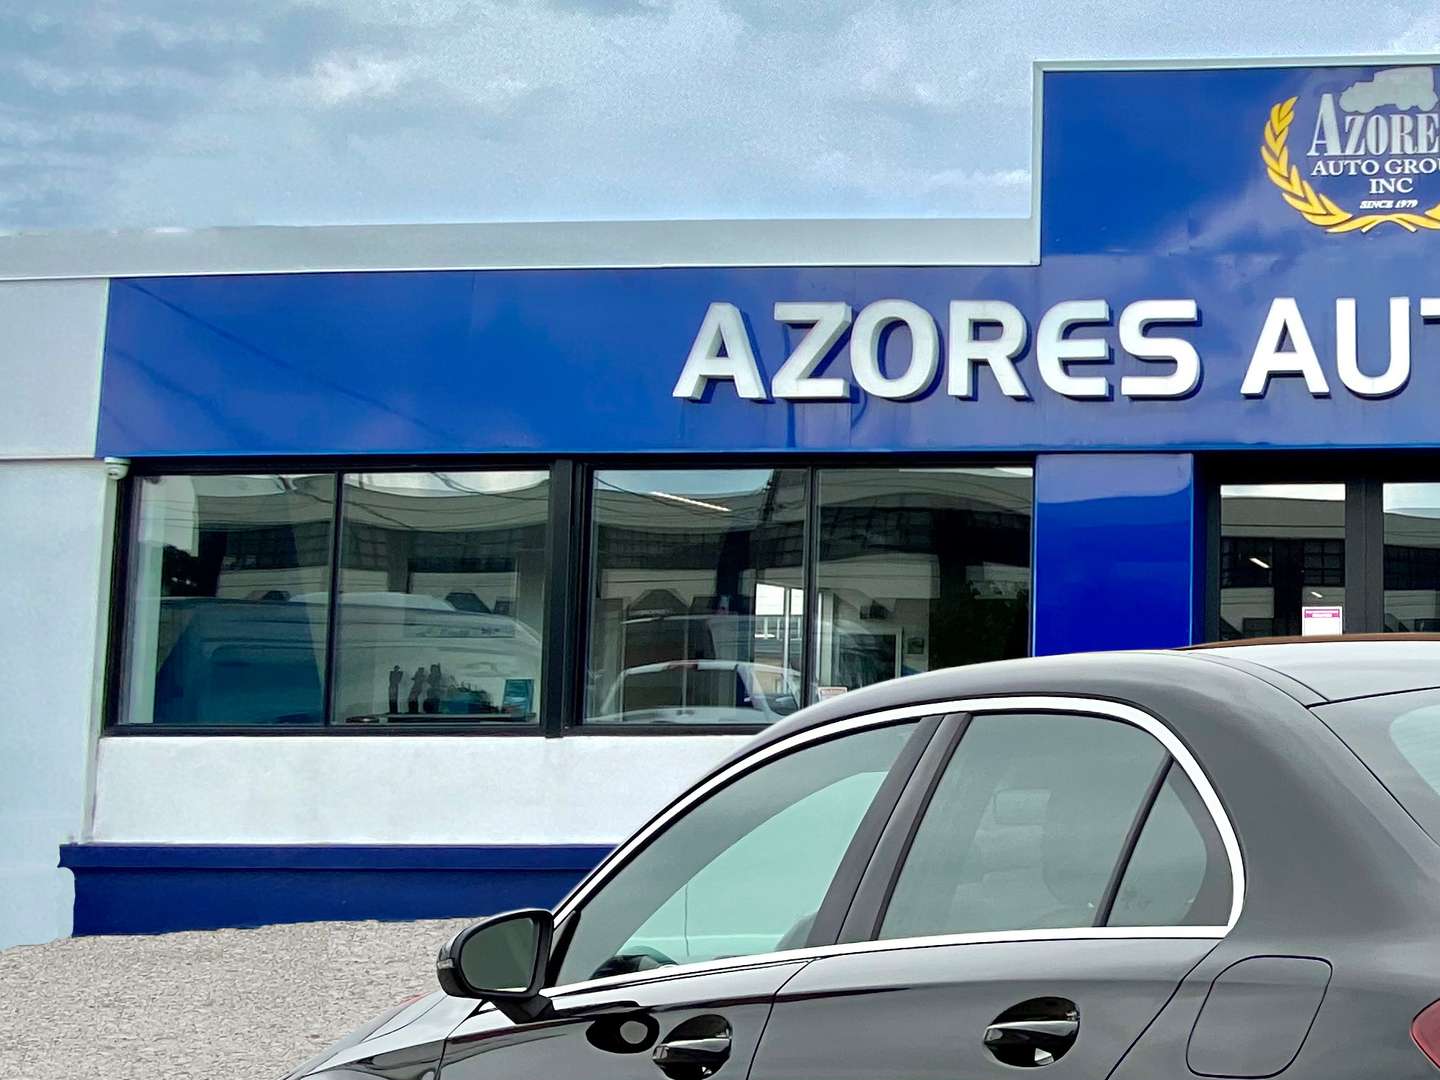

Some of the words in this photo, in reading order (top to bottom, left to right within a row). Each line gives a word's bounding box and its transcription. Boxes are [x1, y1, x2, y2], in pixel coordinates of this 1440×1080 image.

[1311, 159, 1379, 176] AUTO
[1370, 177, 1414, 194] INC
[1359, 200, 1394, 210] SINCE
[1394, 199, 1418, 209] 1979
[671, 298, 1204, 402] AZORES
